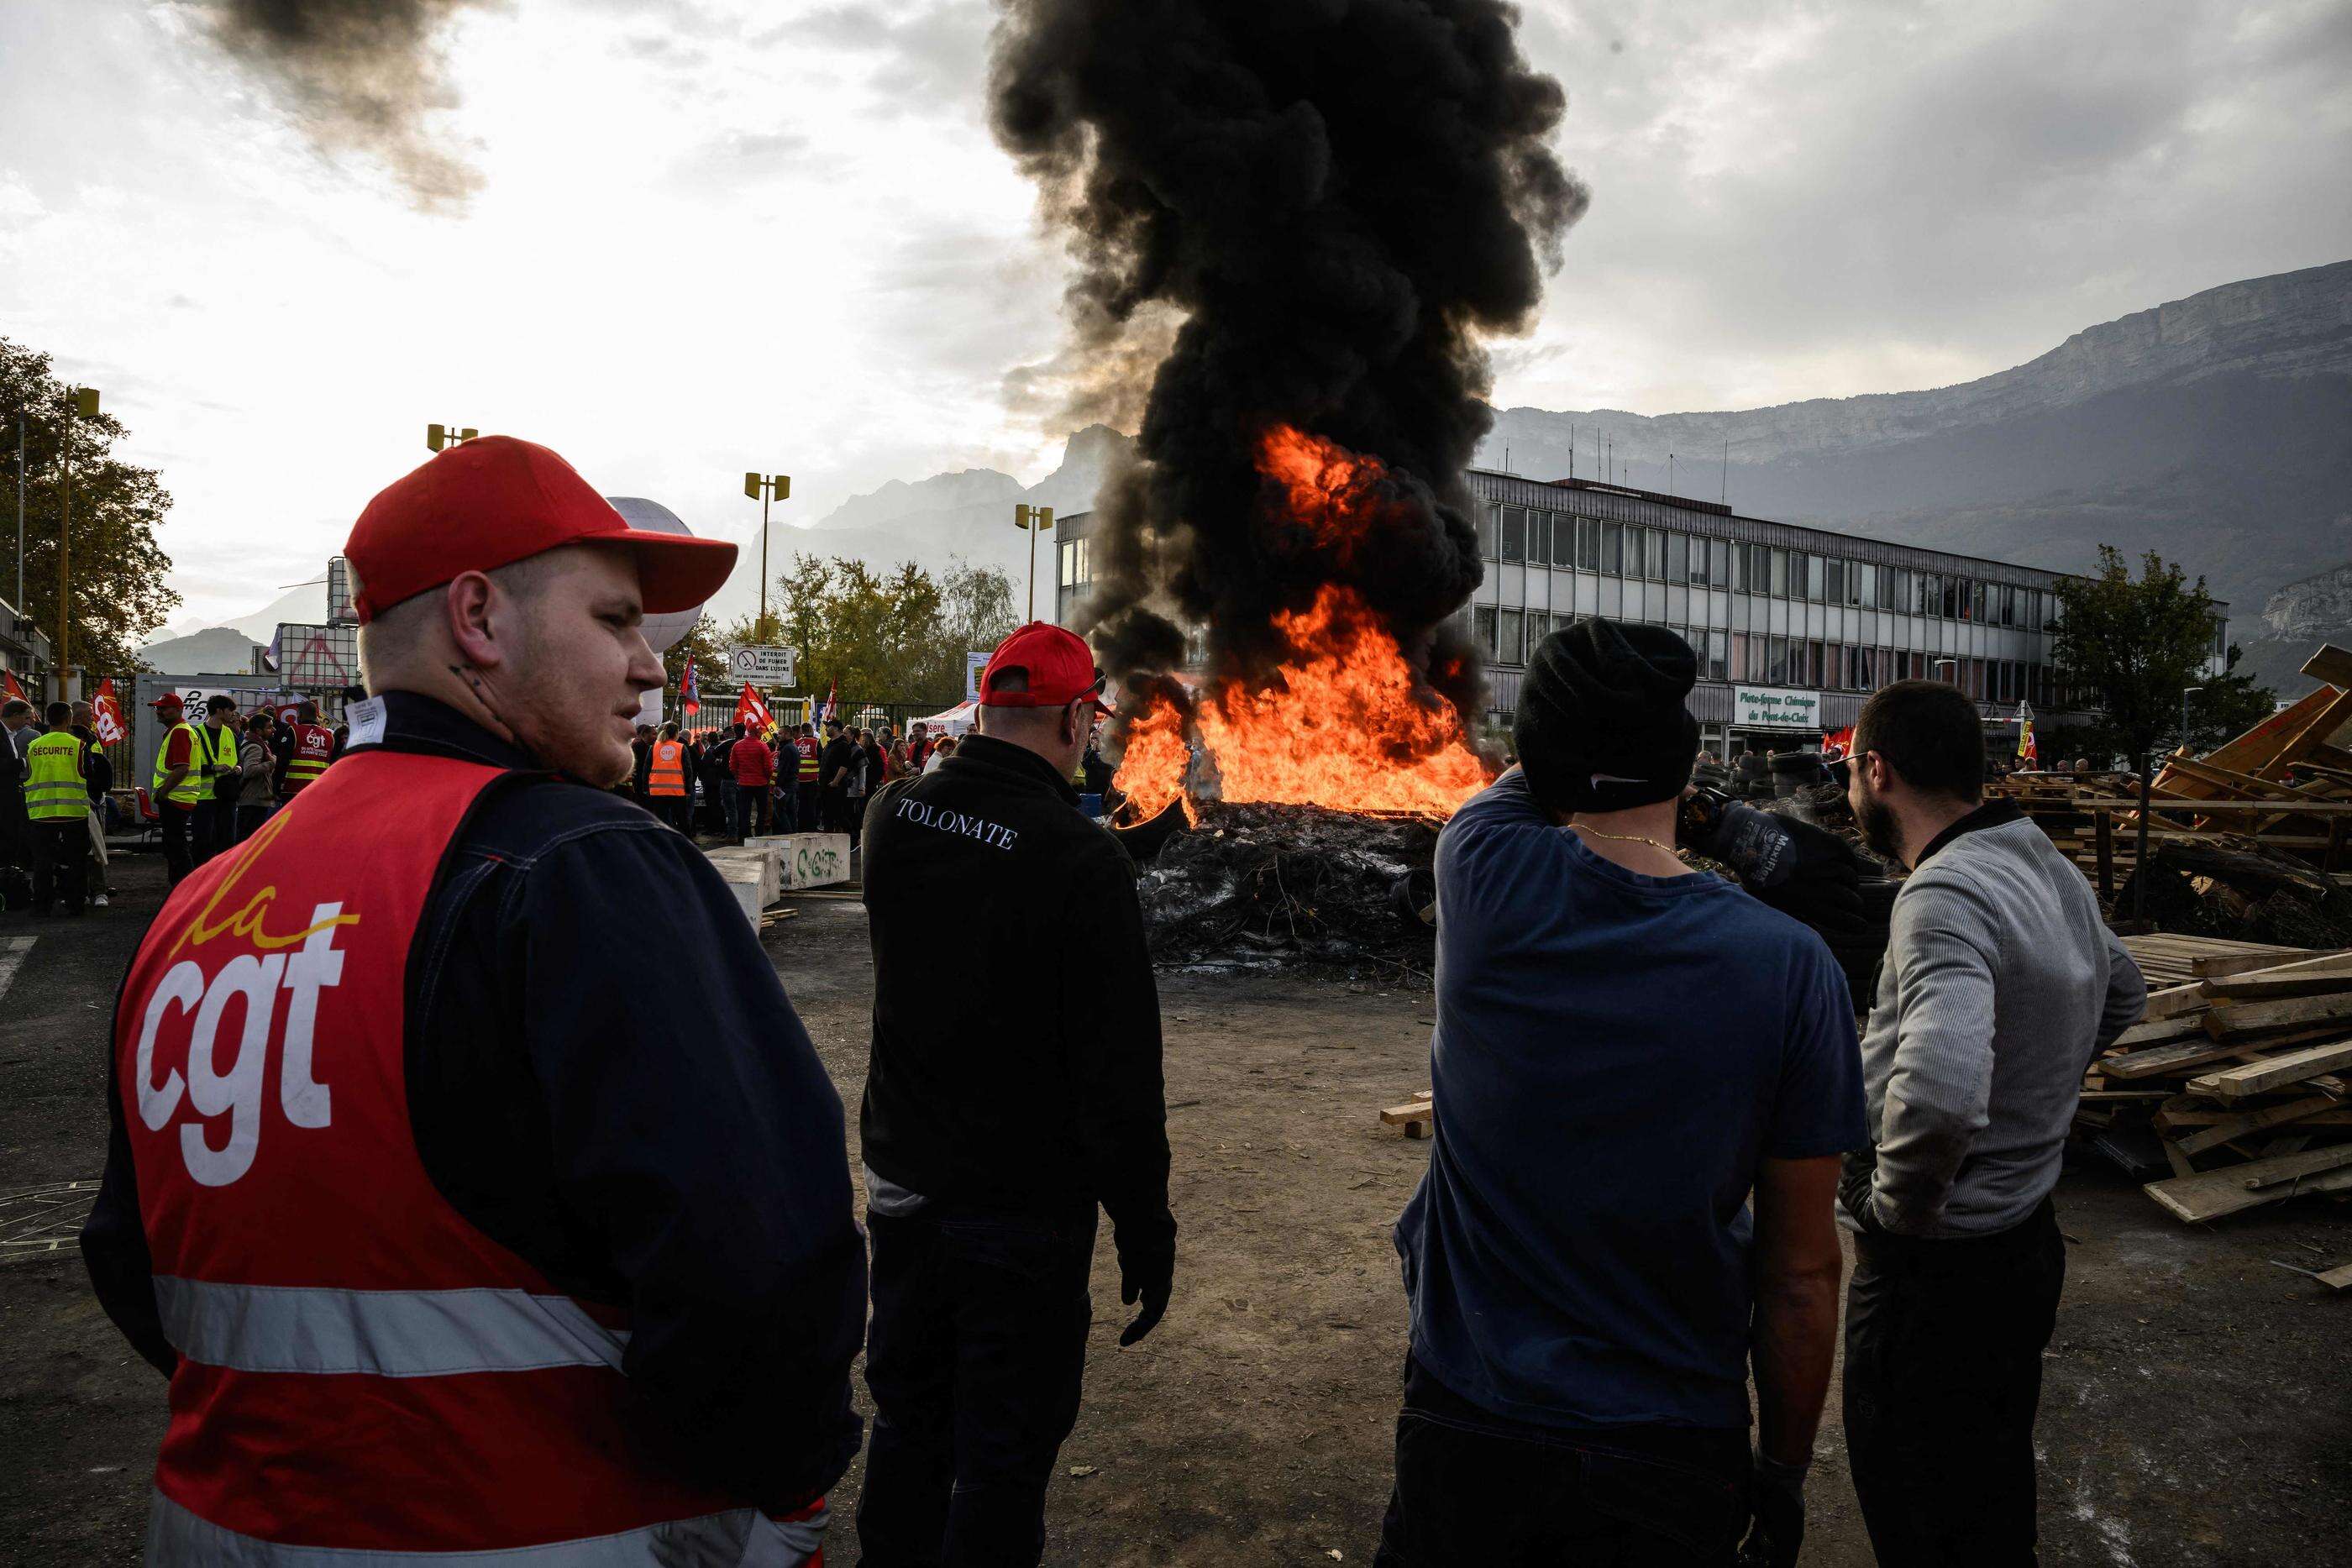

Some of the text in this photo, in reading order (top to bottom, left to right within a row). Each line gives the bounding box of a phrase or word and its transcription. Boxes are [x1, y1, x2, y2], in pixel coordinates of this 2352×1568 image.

[1740, 692, 1816, 706] Plate-forme Chimique
[1748, 710, 1809, 722] du Pont-de-Claix
[307, 735, 326, 748] cgt
[33, 745, 74, 757] SÉCURITÉ
[797, 744, 811, 754] cgt
[895, 798, 1018, 850] TOLONATE
[167, 810, 360, 959] la
[136, 901, 345, 1187] cgt
